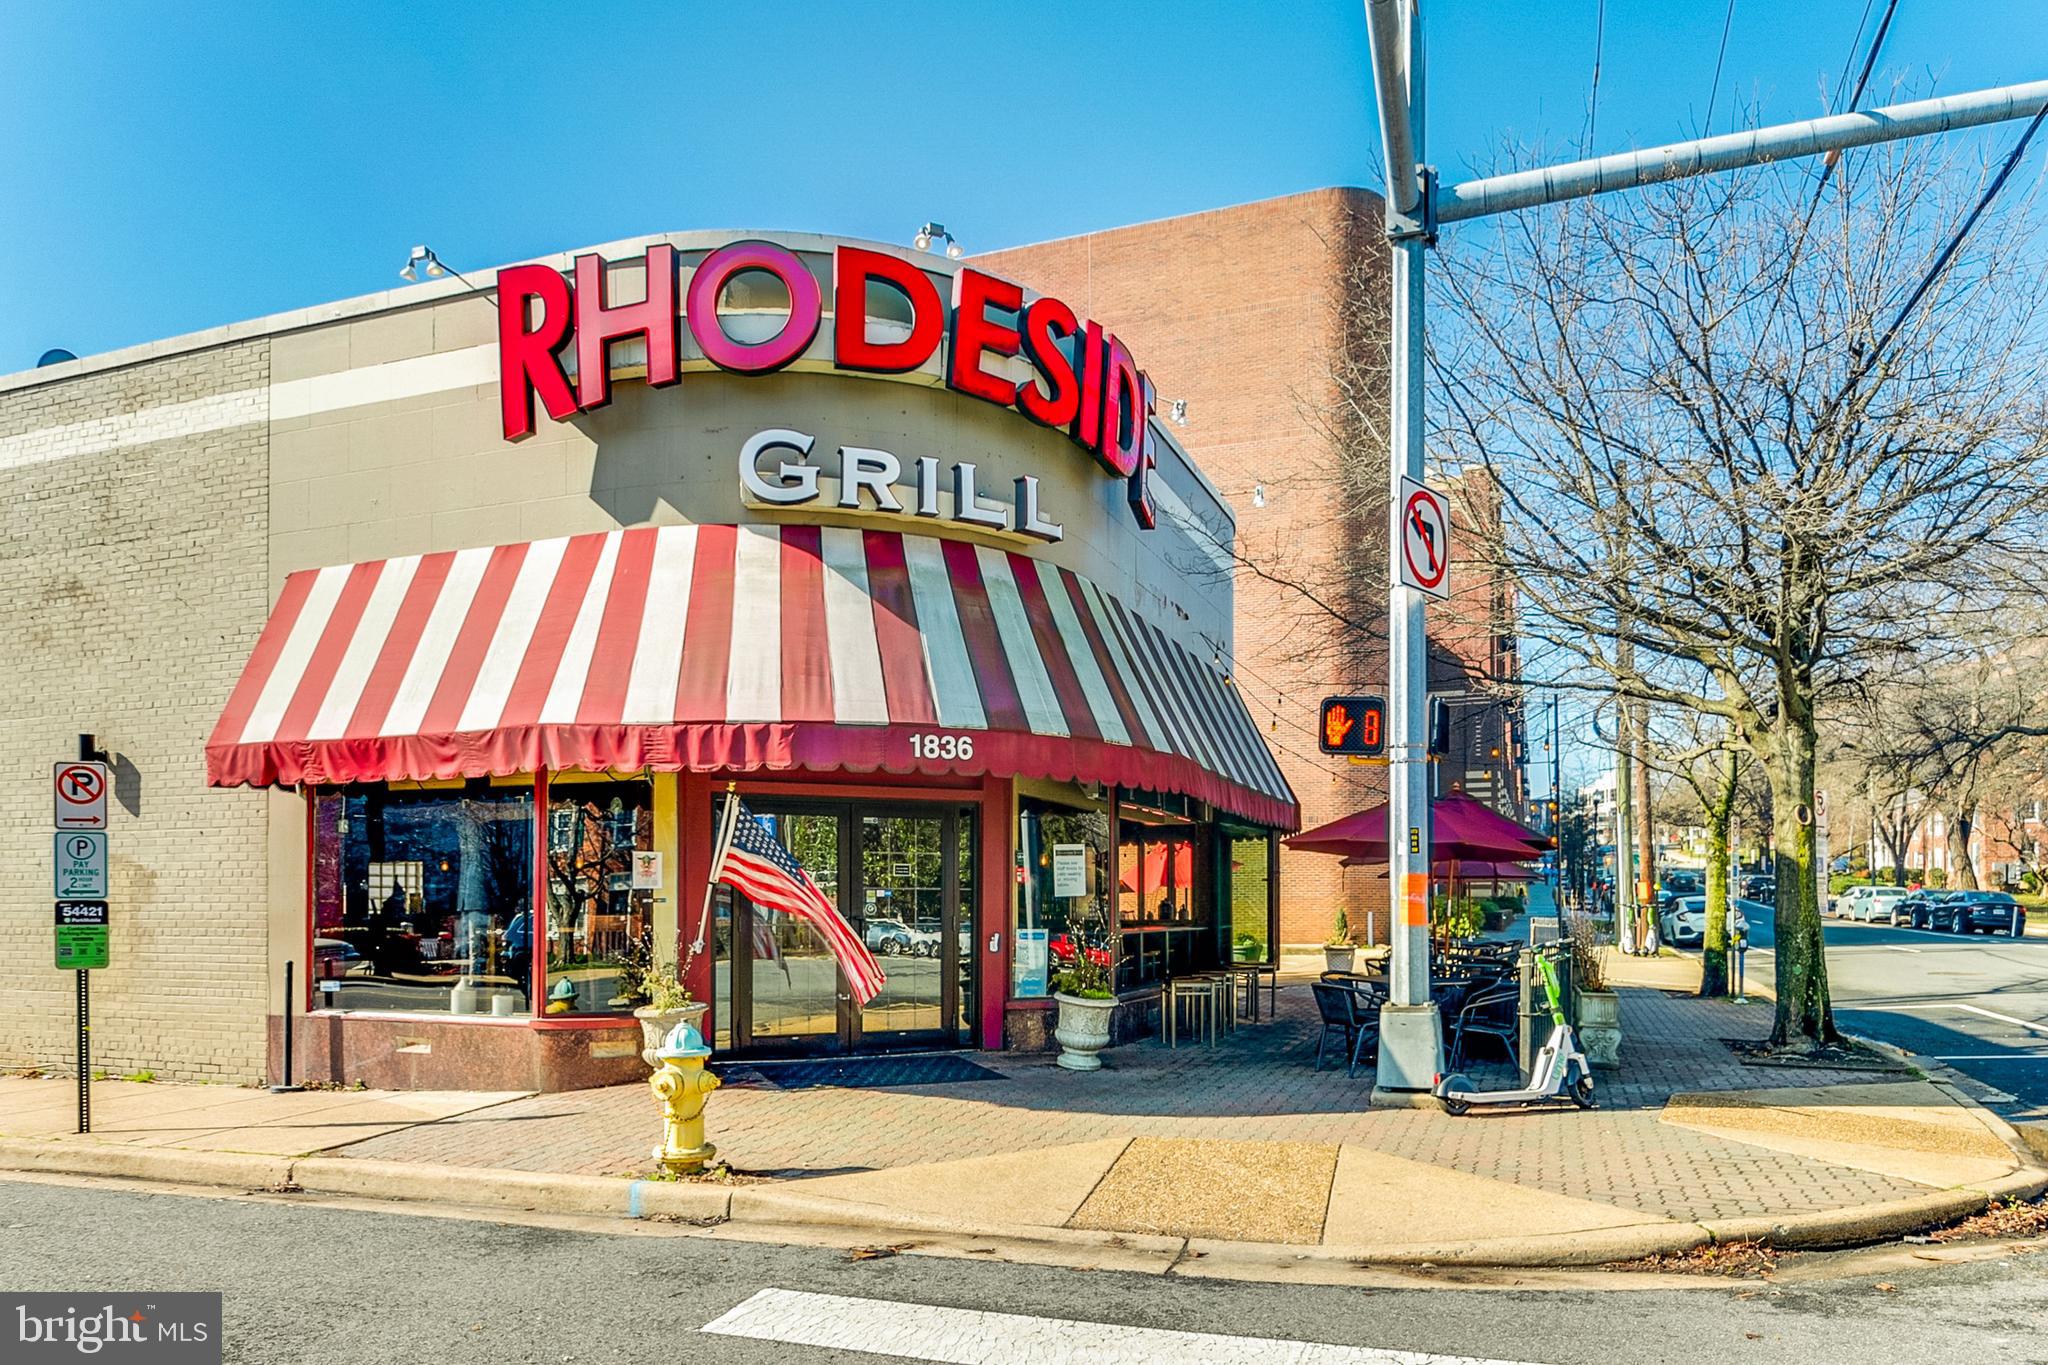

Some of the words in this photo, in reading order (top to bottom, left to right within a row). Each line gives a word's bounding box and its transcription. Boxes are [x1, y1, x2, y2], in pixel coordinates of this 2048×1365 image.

[497, 239, 1157, 532] RHODESIDE
[738, 428, 1064, 544] GRILL
[909, 733, 974, 761] 1836
[76, 840, 88, 856] P
[73, 860, 90, 868] PAY
[62, 868, 100, 876] PARKING
[70, 876, 78, 889] 2
[61, 906, 103, 917] 54421
